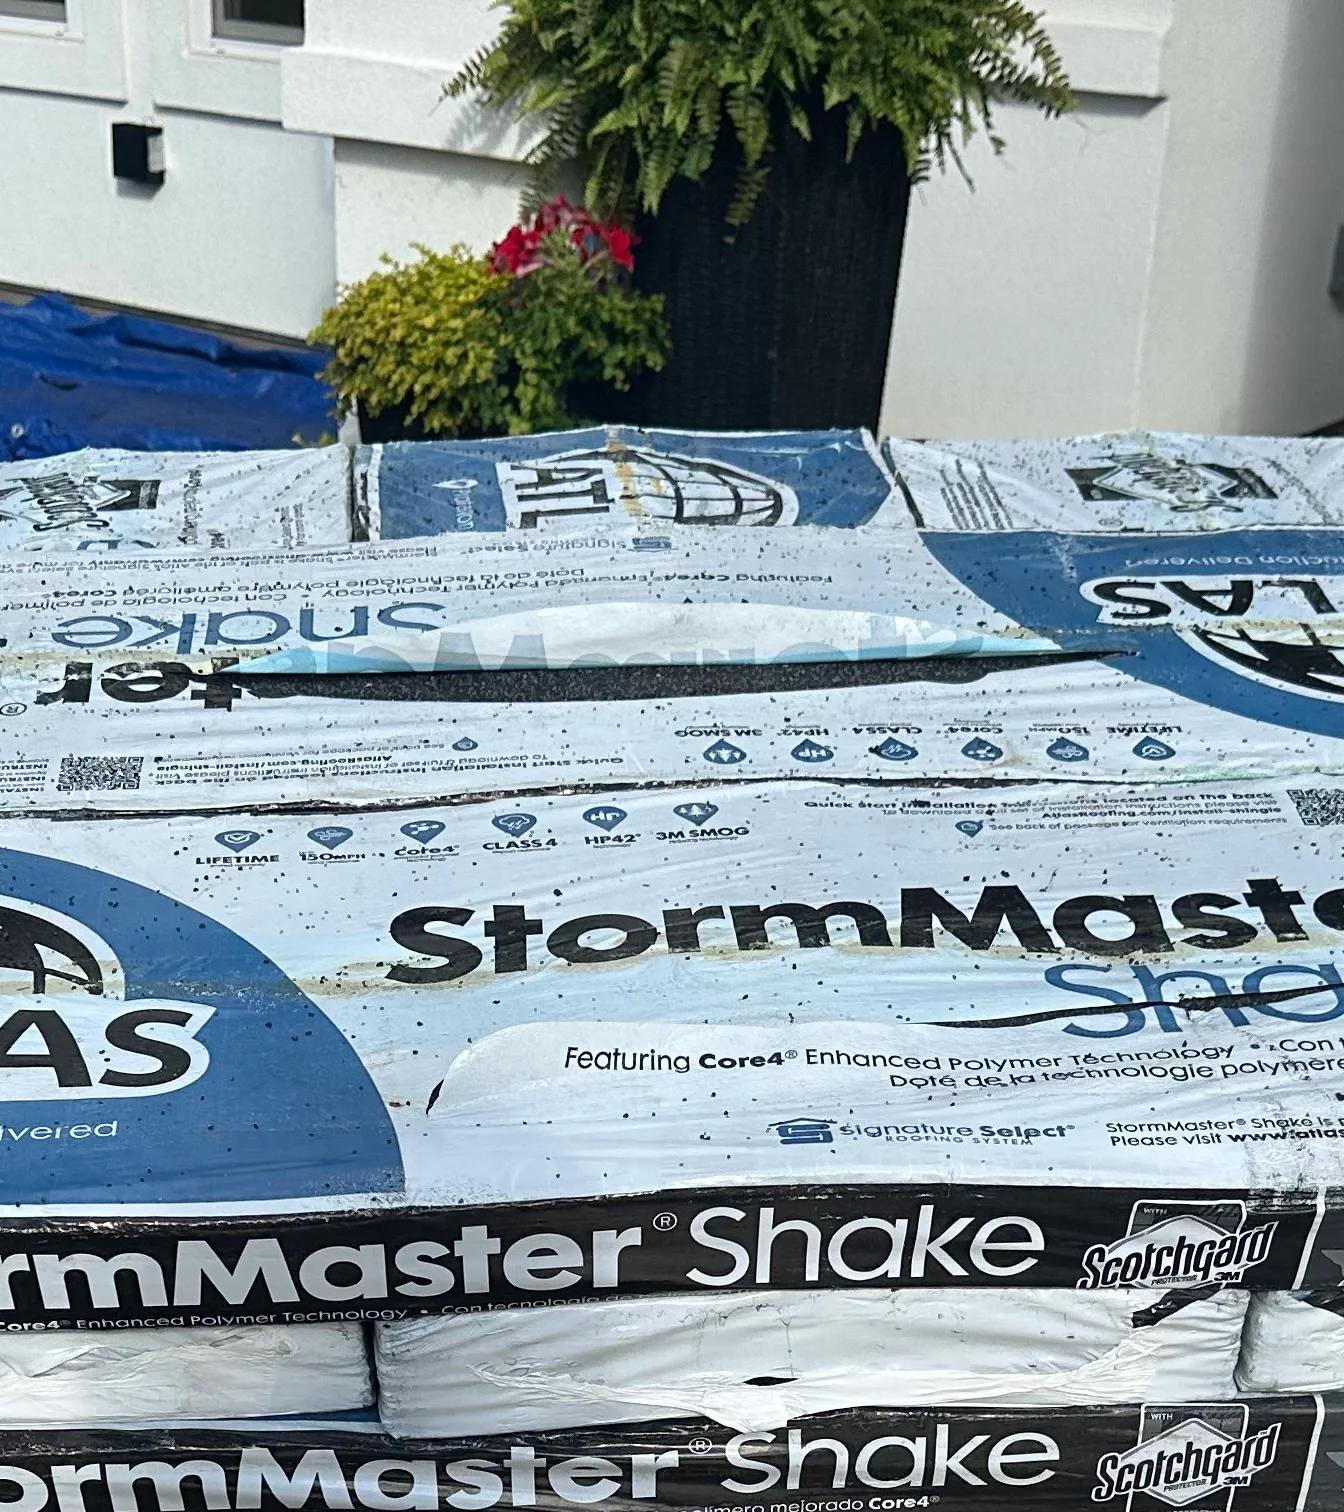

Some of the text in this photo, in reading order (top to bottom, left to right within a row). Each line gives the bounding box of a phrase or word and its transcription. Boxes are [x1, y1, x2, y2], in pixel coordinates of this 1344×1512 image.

[1123, 553, 1252, 568] Delivered
[1103, 796, 1168, 804] located
[656, 827, 750, 840] 3M SMOG
[195, 854, 280, 865] LIFETIME
[564, 1046, 690, 1074] Featuring
[806, 1049, 942, 1070] Enhanced
[949, 1057, 1063, 1072] Polymer
[1069, 1045, 1234, 1066] Technology
[1279, 1039, 1334, 1052] Con
[890, 1074, 956, 1087] Doté
[964, 1076, 1002, 1087] de
[1009, 1073, 1036, 1084] la
[1042, 1065, 1214, 1081] technologie
[840, 1123, 974, 1137] Signature
[1251, 1117, 1313, 1129] Shake
[1317, 1117, 1335, 1126] is
[972, 1138, 1033, 1146] SYSTEM
[1110, 1135, 1178, 1146] Please
[1184, 1133, 1222, 1145] visit
[685, 1204, 1047, 1288] Shake
[1075, 1220, 1273, 1289] Scotchgard
[1213, 1270, 1245, 1284] 3M
[76, 1315, 185, 1330] Enhanced
[191, 1311, 270, 1328] Polymer
[275, 1306, 408, 1324] Technology
[1150, 1411, 1174, 1421] WITH
[722, 1423, 1060, 1493] Shake
[1091, 1421, 1282, 1501] Scotchgard
[1223, 1475, 1250, 1487] 3M
